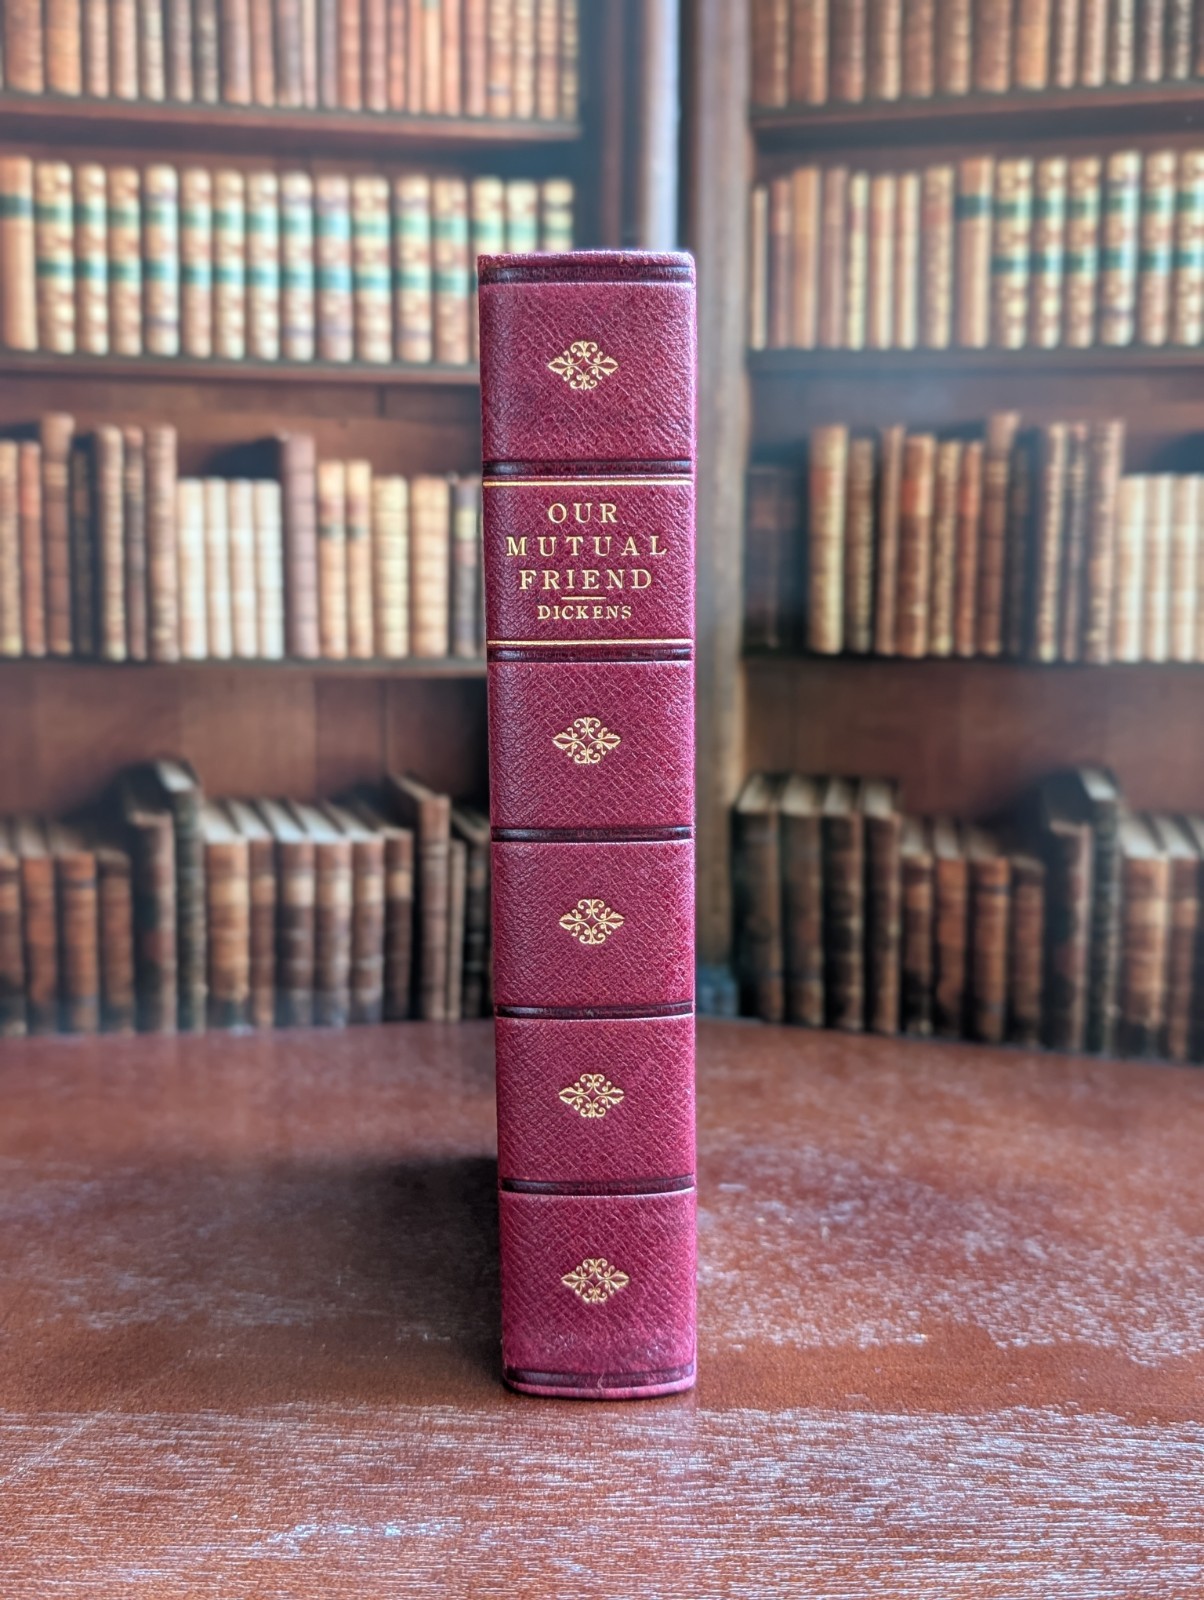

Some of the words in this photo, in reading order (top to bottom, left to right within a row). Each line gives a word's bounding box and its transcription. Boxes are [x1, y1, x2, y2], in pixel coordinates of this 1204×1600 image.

[548, 503, 618, 524] OUR
[506, 535, 668, 557] MUTUAL
[519, 569, 652, 590] FRIEND
[537, 605, 632, 620] DICKENS
